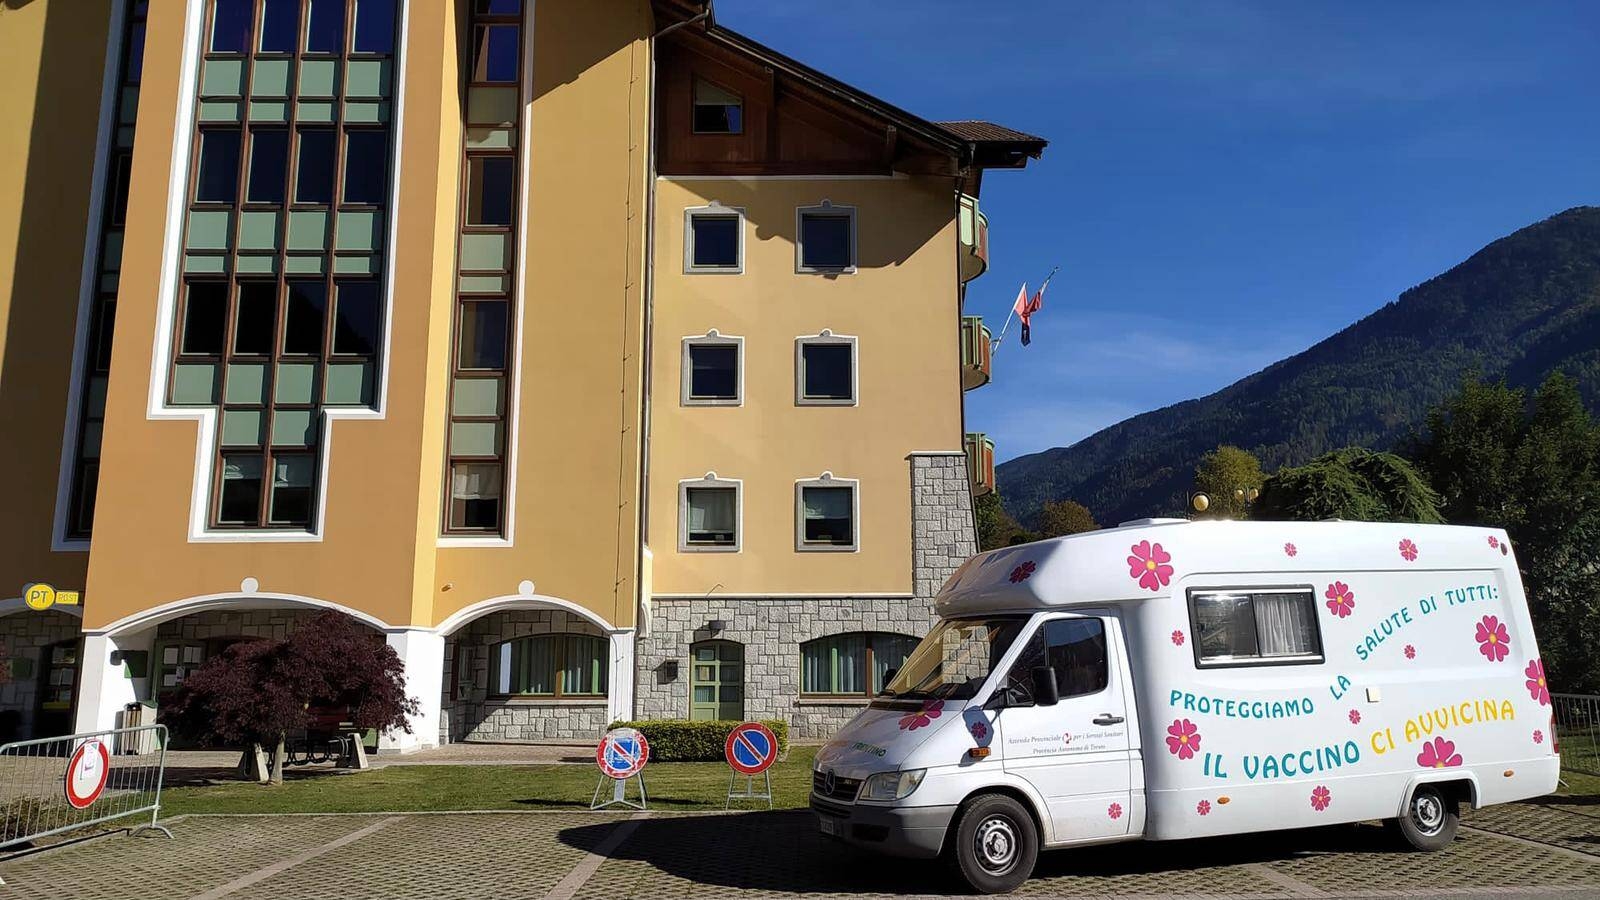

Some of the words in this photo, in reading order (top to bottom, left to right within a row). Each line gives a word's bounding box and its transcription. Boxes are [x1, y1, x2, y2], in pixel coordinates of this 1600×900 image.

[30, 590, 49, 603] PT
[1170, 689, 1314, 719] PROTEGGIAMO
[1330, 675, 1351, 700] LA
[1356, 608, 1412, 660] SALUTE
[1420, 598, 1438, 615] DI
[1445, 585, 1499, 606] TUTTI:
[1203, 752, 1228, 778] IL
[1243, 740, 1361, 780] VACCINO
[1370, 726, 1396, 755] CI
[1404, 700, 1515, 743] AVVICINA
